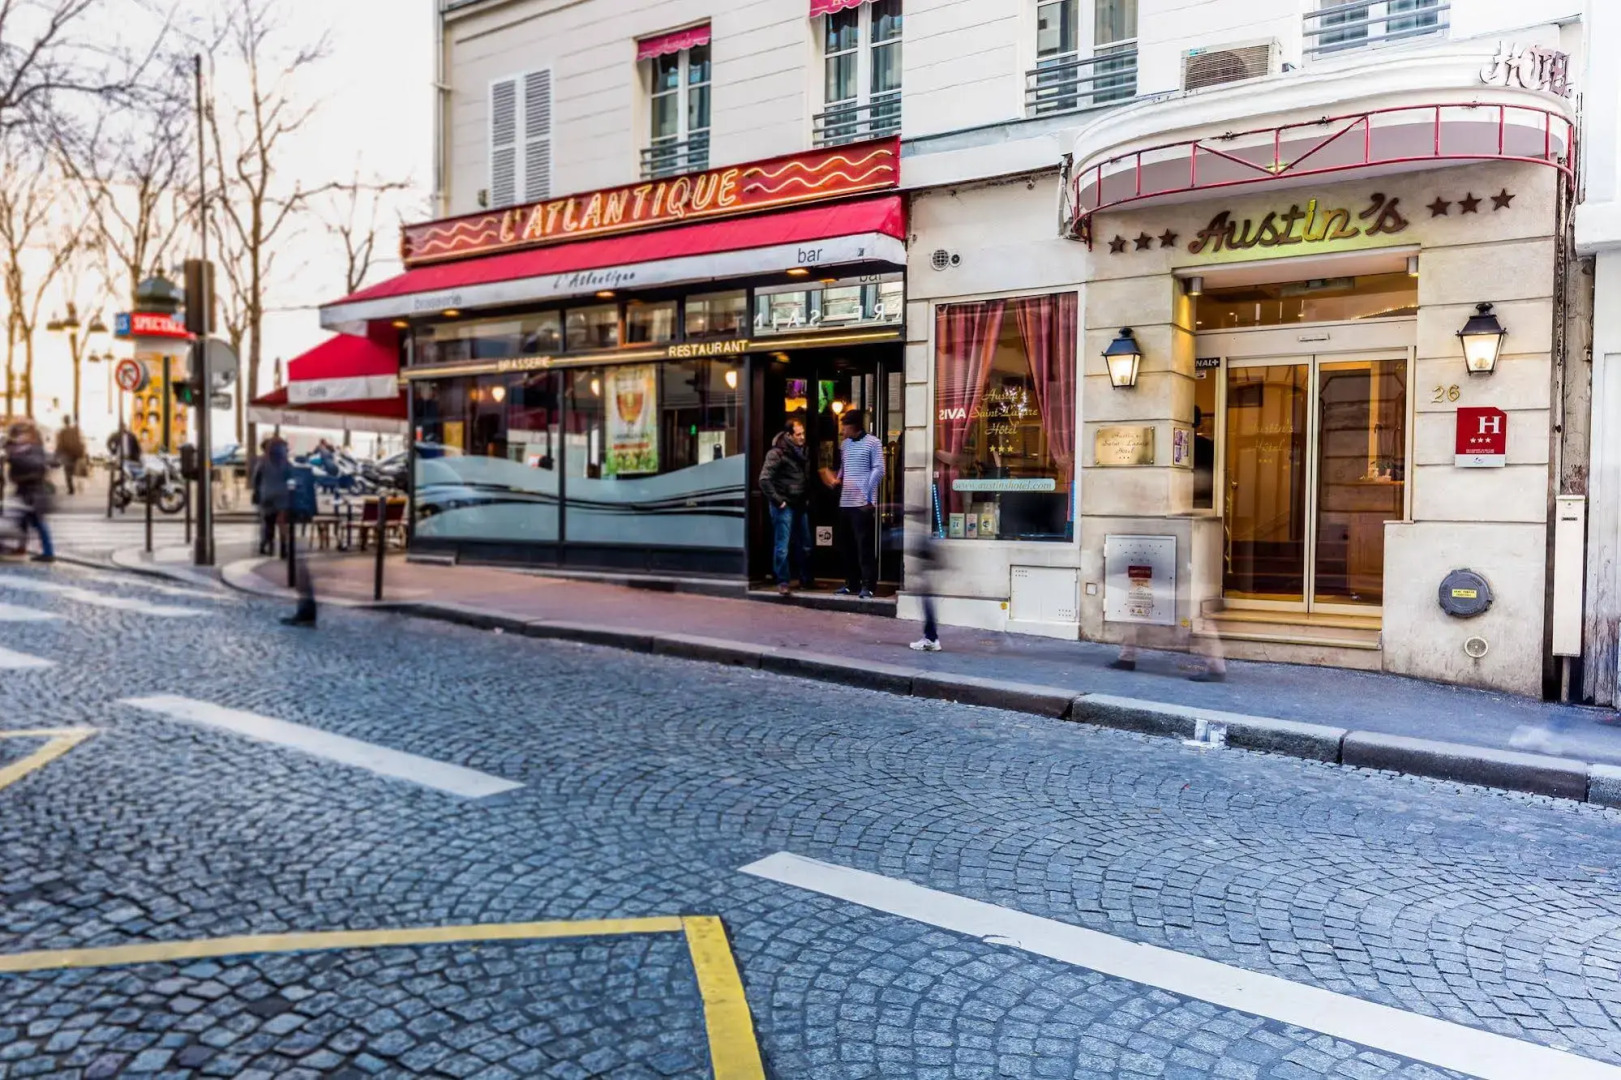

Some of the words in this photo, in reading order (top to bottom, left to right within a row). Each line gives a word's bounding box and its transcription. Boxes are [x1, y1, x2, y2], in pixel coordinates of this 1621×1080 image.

[499, 168, 739, 243] L'ATLANTIQUE
[1188, 192, 1409, 254] Austin's
[797, 248, 823, 264] bar
[668, 339, 749, 358] RESTAURANT
[498, 355, 551, 370] BRASSERIE
[1431, 384, 1460, 404] 26
[1477, 415, 1502, 434] H
